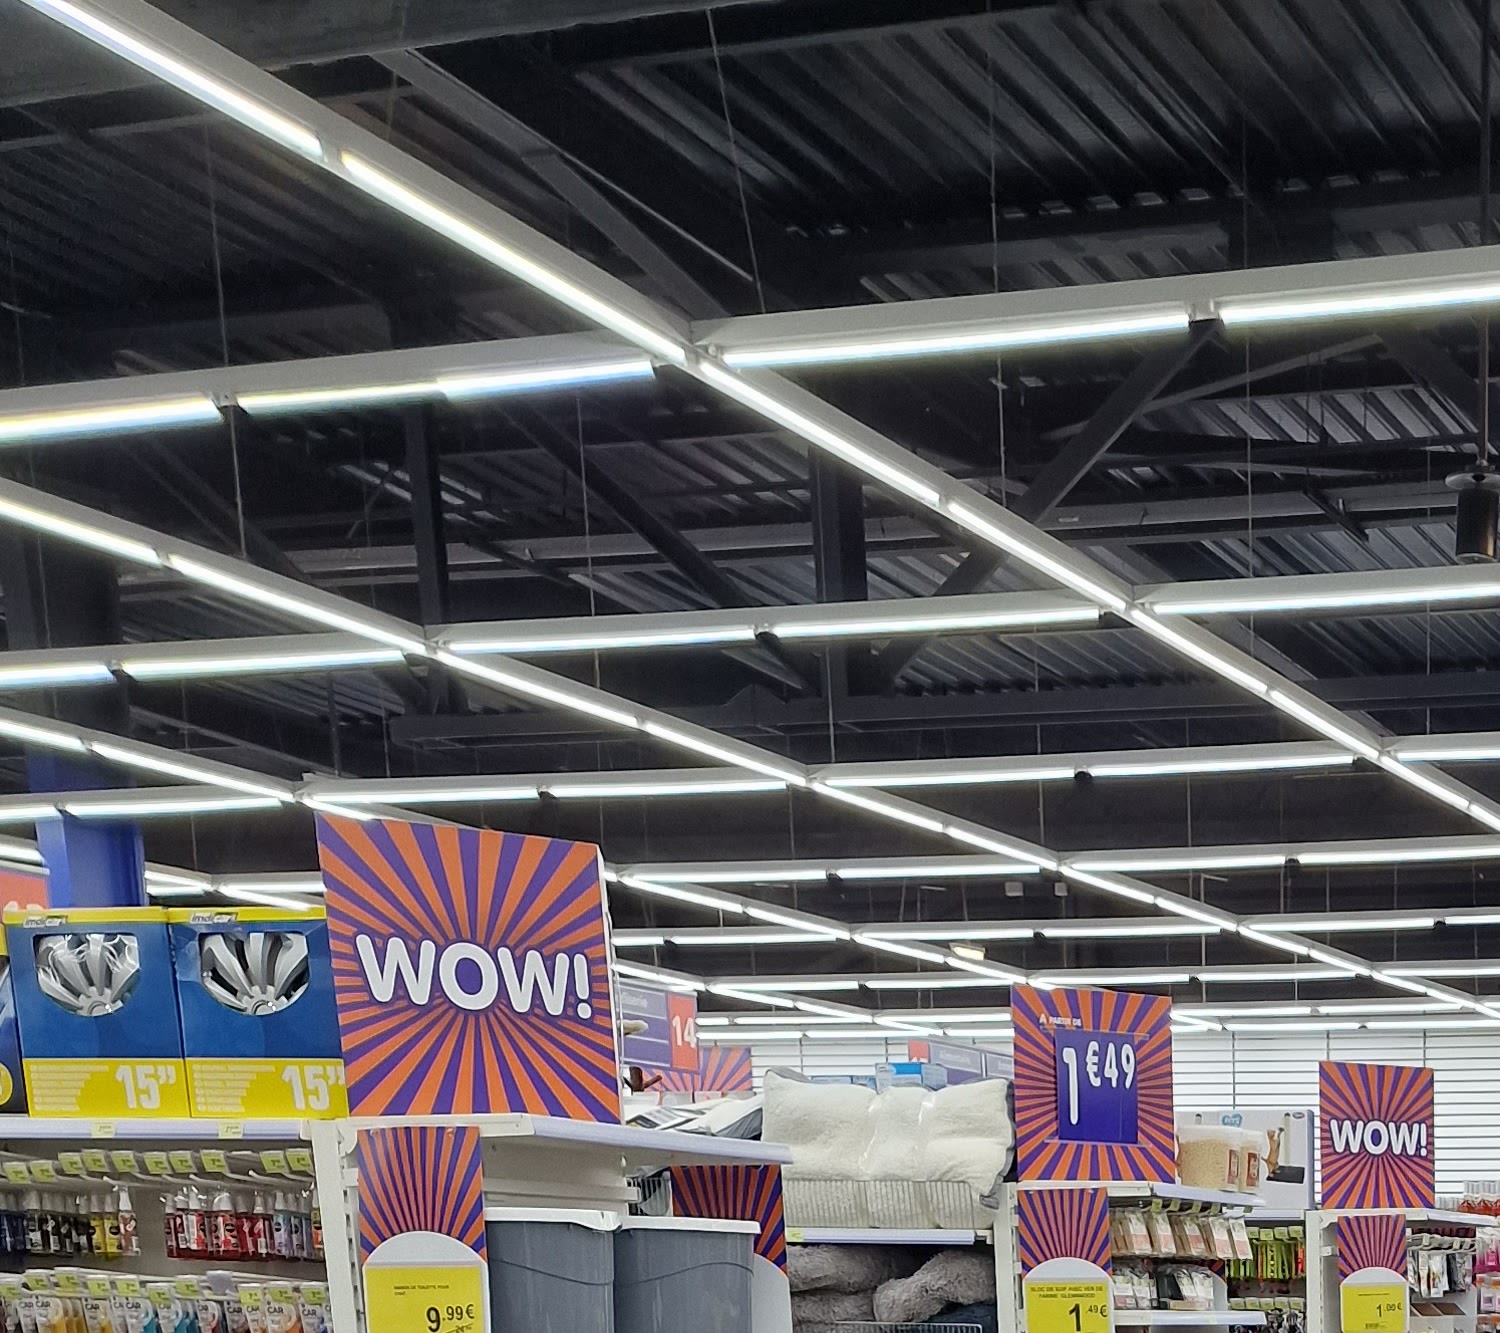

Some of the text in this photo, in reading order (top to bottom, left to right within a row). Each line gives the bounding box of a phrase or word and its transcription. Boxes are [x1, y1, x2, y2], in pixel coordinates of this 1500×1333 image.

[355, 934, 592, 1020] WOW!
[672, 1015, 697, 1048] 14
[1330, 1119, 1427, 1157] WOW!
